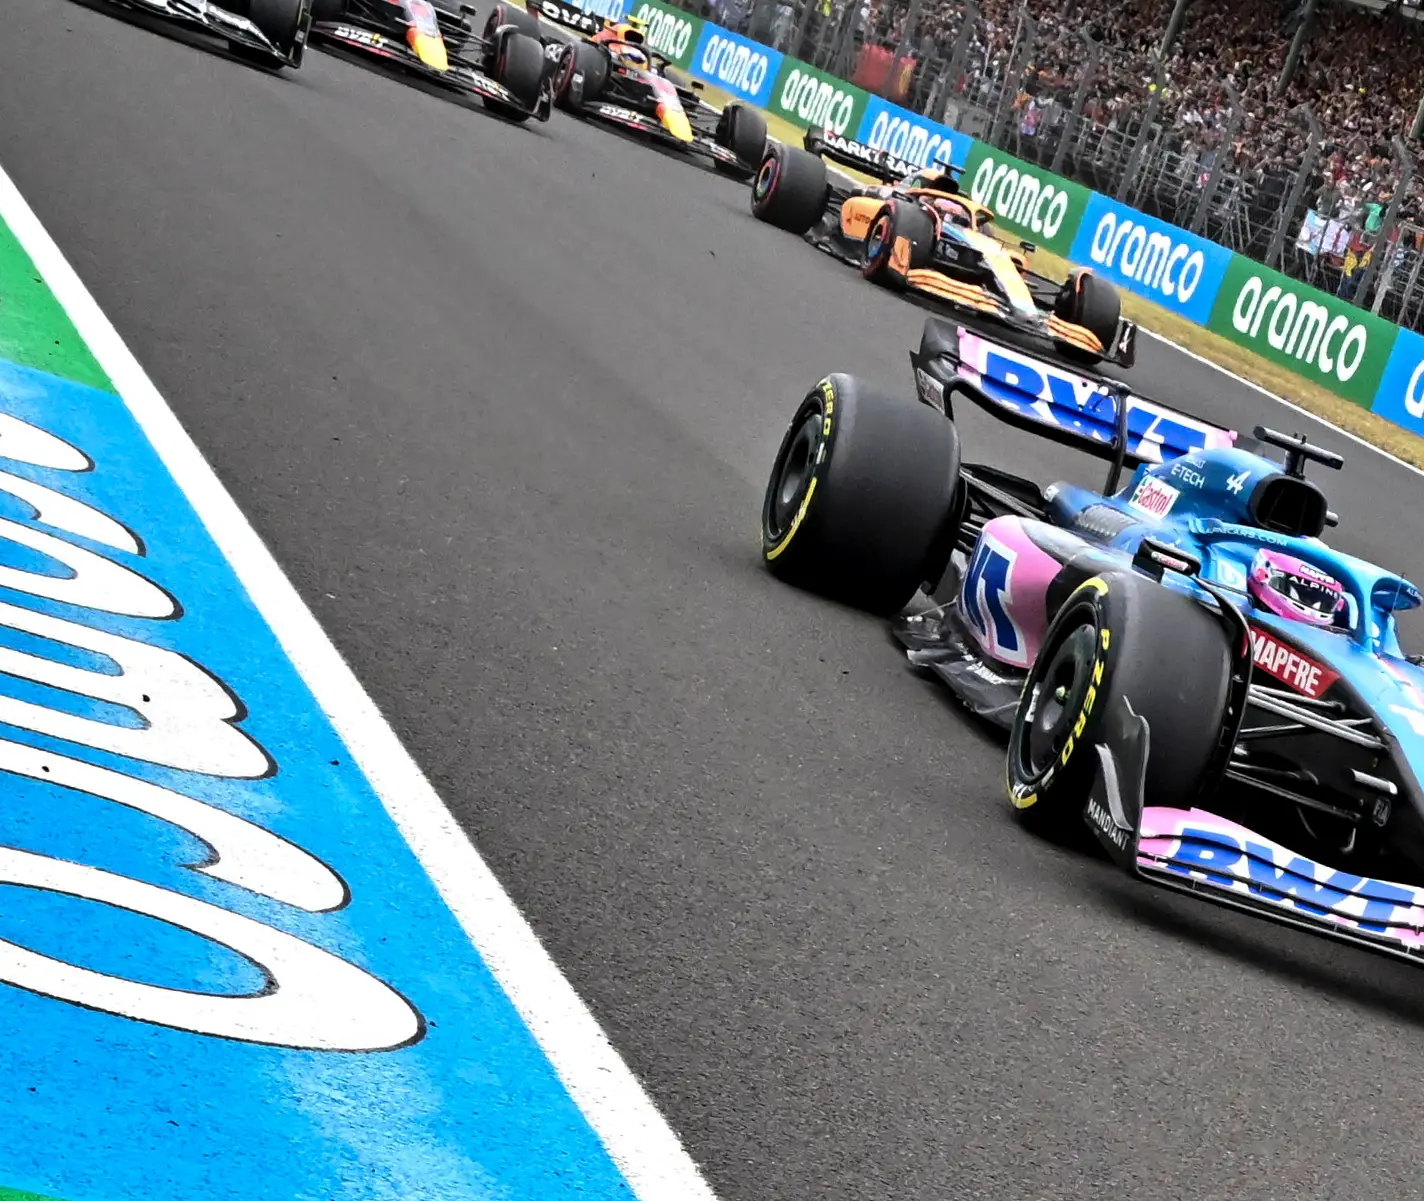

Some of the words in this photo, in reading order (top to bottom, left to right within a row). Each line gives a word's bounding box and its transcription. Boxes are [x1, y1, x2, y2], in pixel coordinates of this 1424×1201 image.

[636, 4, 692, 60] aramco
[702, 35, 768, 96] aramco
[780, 69, 853, 134] aramco
[868, 111, 952, 170] aramco
[970, 157, 1069, 239] aramco
[1090, 212, 1204, 303] aramco
[1232, 275, 1367, 382] aramco
[981, 349, 1207, 464] BWT
[1171, 464, 1205, 489] E-TECH
[1250, 631, 1323, 697] MAPFRE
[1061, 658, 1105, 766] ZERO
[1086, 798, 1130, 851] MANDIANT
[1165, 827, 1416, 932] BWT
